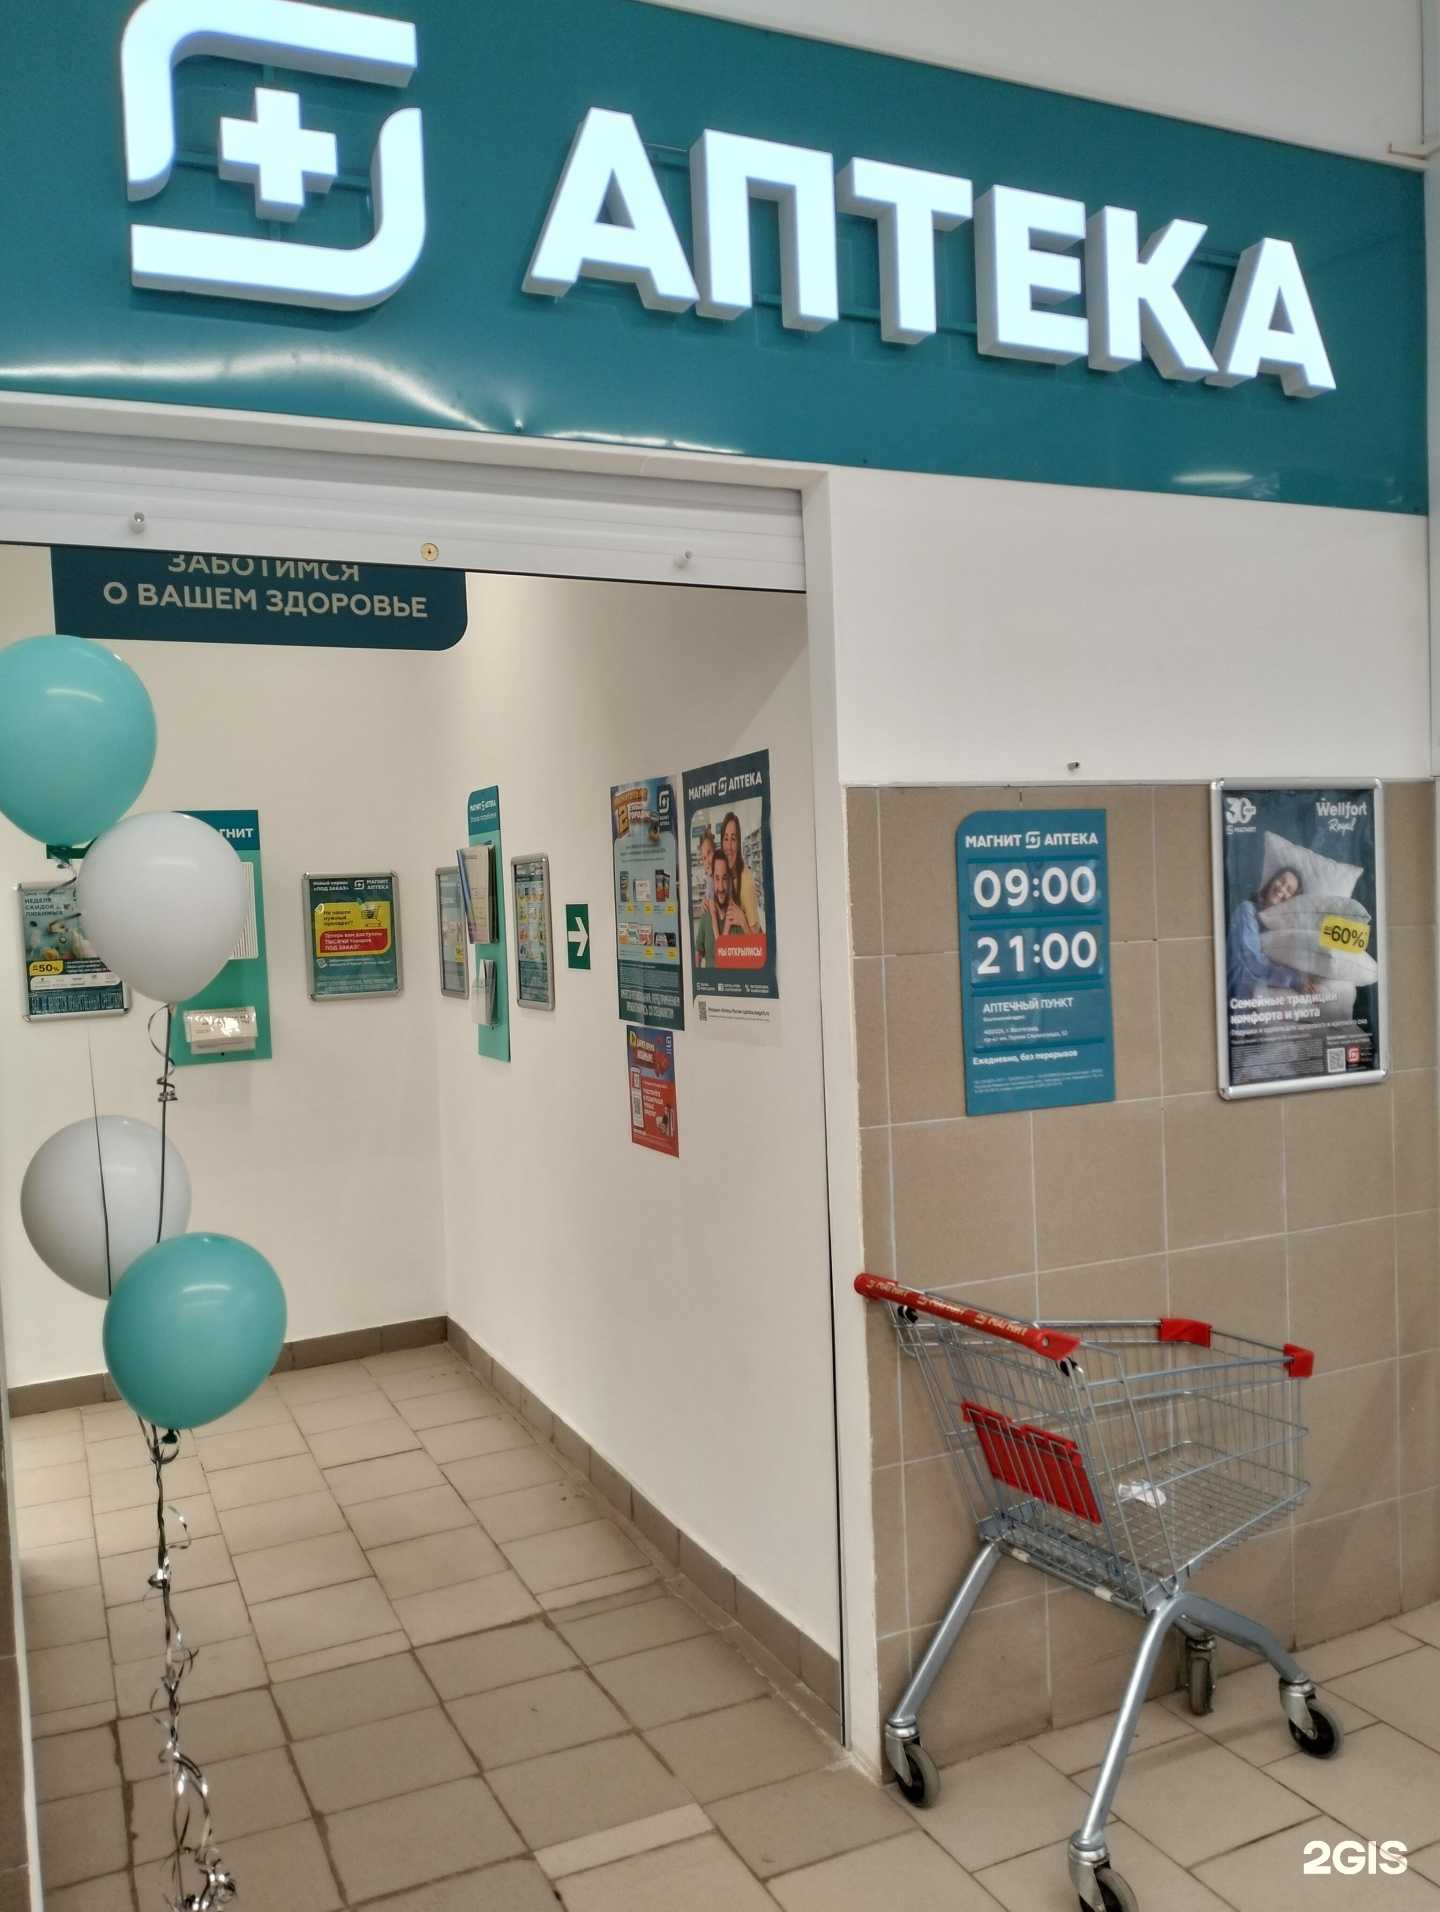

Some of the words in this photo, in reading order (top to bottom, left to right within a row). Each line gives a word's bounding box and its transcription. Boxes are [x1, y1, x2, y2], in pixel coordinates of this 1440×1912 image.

[523, 107, 1336, 396] АПТЕКА
[167, 554, 360, 583] ЗАБОТИМСЯ
[102, 581, 127, 605] О
[138, 583, 257, 611] ВАШЕМ
[265, 589, 429, 619] ЗДОРОВЬЕ
[688, 781, 717, 801] МАГНИТ
[728, 771, 763, 792] АПТЕКА
[1316, 797, 1368, 818] Wellfort
[965, 833, 1022, 849] МАГНИТ
[1043, 831, 1099, 847] АПТЕКА
[973, 865, 1097, 908] 09:00
[976, 930, 1098, 976] 21:00
[982, 998, 1040, 1014] АПТЕЧНЫЙ
[1040, 996, 1074, 1010] ПУНКТ
[1230, 994, 1285, 1010] Семейные
[1287, 990, 1338, 1006] традиции
[1230, 1009, 1283, 1025] комфорта
[1283, 1010, 1292, 1019] и
[1293, 1007, 1321, 1022] уюта
[1020, 1052, 1034, 1062] без
